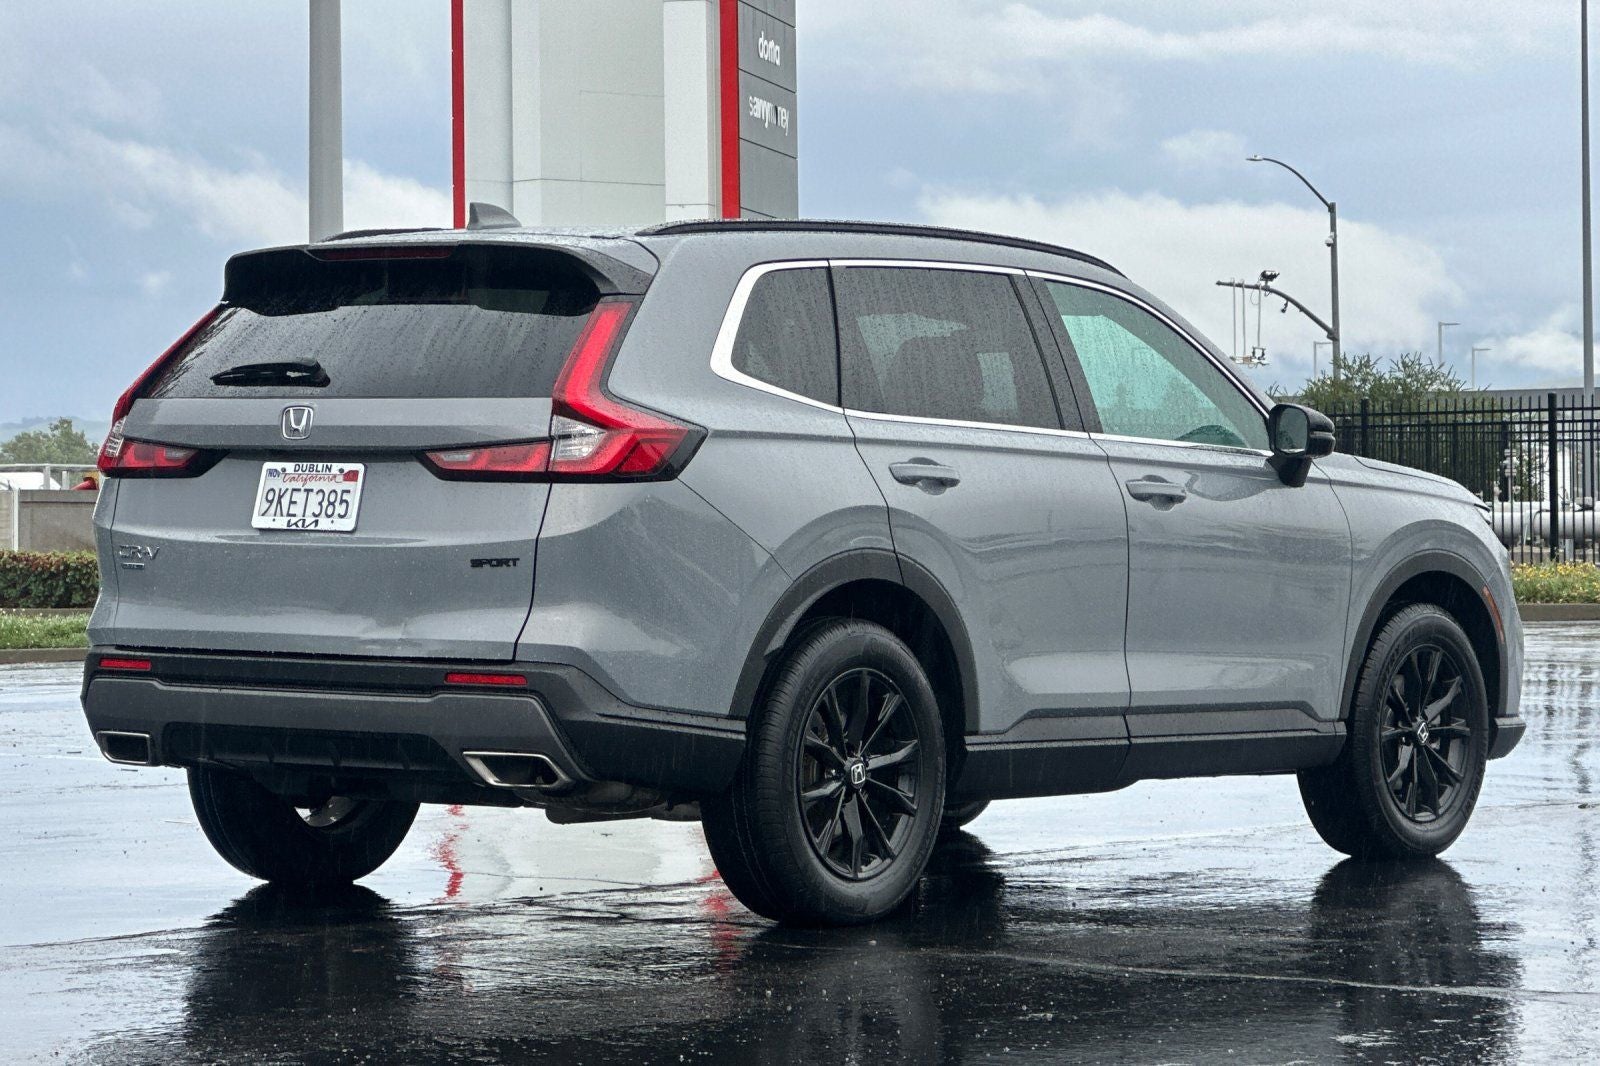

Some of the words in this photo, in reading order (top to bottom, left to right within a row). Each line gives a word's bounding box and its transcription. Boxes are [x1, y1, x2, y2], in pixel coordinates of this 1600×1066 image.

[293, 463, 333, 473] DUBLIN
[261, 487, 351, 519] 9KET385
[286, 518, 319, 528] KIA
[470, 557, 520, 568] SPORT
